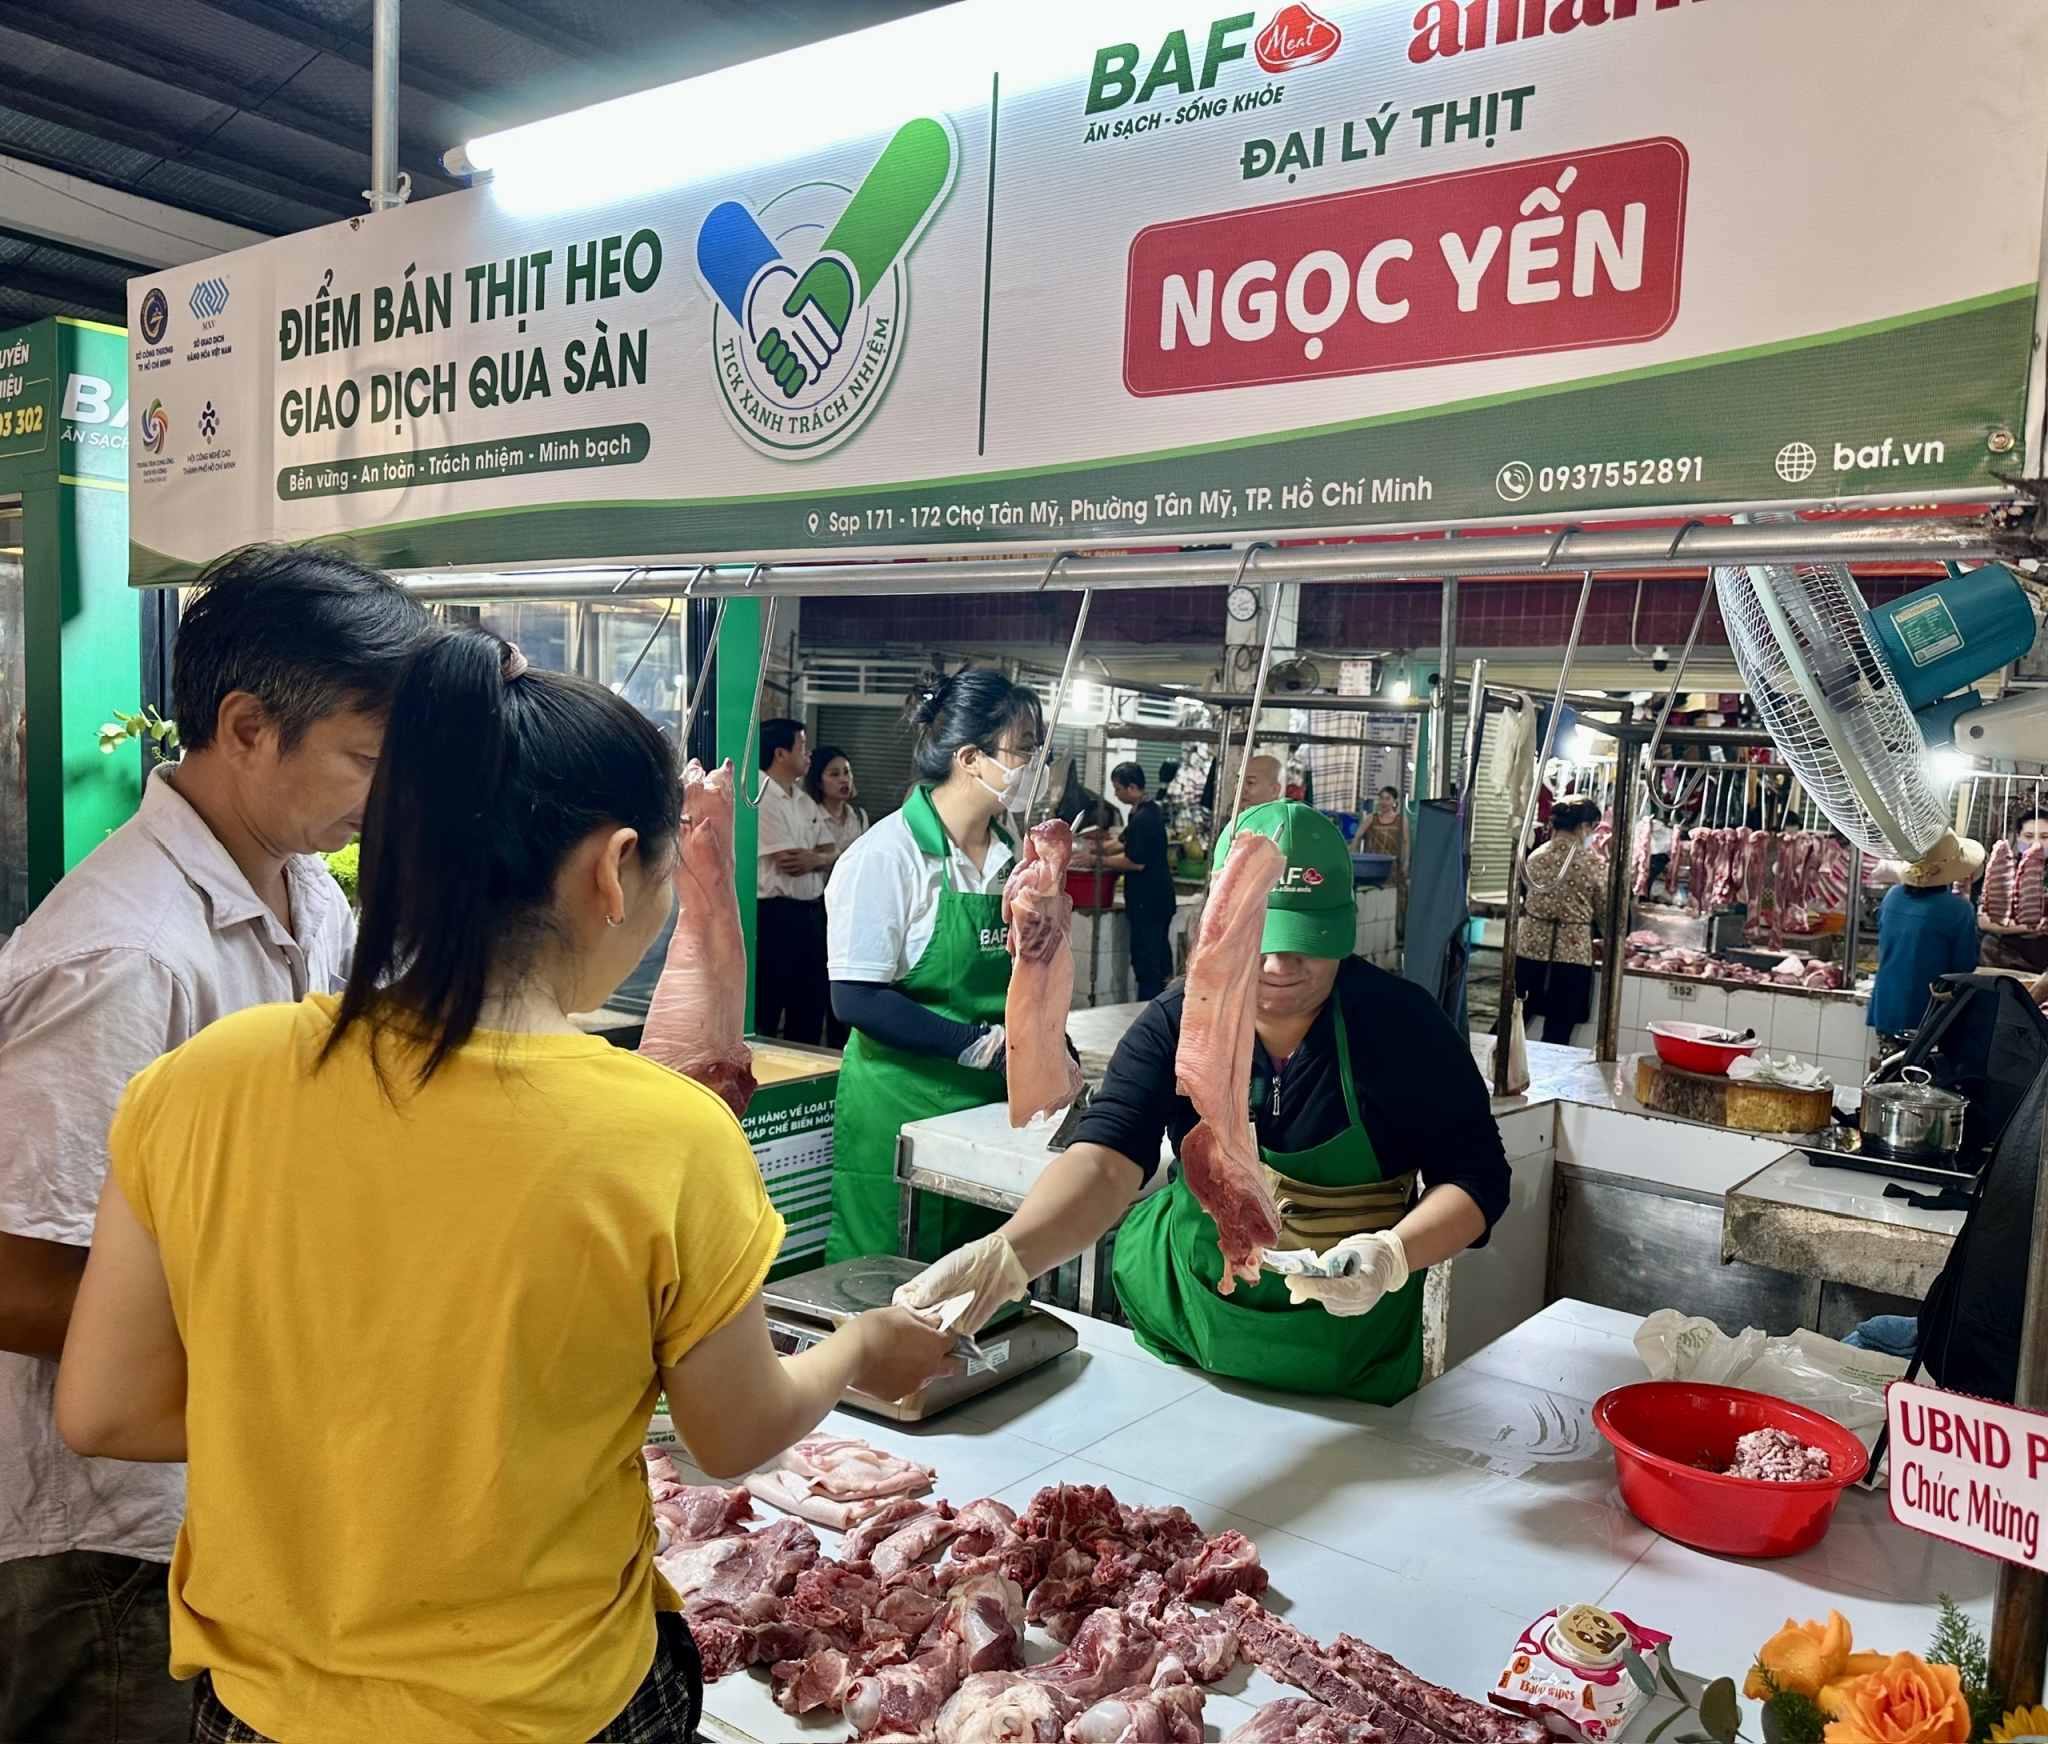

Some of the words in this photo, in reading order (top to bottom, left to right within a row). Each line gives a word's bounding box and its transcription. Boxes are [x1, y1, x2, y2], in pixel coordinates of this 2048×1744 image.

[1085, 12, 1256, 115] BAF
[1264, 24, 1318, 58] Meat
[1083, 122, 1109, 143] ĂN
[1112, 112, 1162, 140] SẠCH
[1175, 96, 1227, 125] SỐNG
[1232, 83, 1285, 113] KHỎE
[1239, 126, 1325, 184] ĐẠI
[1340, 101, 1401, 163] LÝ
[1412, 85, 1536, 149] THỊT
[1159, 237, 1414, 361] NGỌC
[1438, 165, 1647, 313] YẾN
[279, 268, 361, 361] ĐIỂM
[373, 261, 452, 343] BÁN
[465, 248, 553, 333] THỊT
[566, 228, 663, 305] HEO
[202, 320, 216, 331] MXV
[280, 379, 360, 437] GIAO
[371, 362, 456, 434] DỊCH
[468, 353, 551, 409] QUA
[563, 320, 648, 395] SÀN
[721, 338, 744, 393] TICK
[739, 388, 784, 434] XANH
[788, 394, 849, 434] TRÁCH
[848, 317, 890, 399] NHIỆM
[15, 405, 43, 435] 302
[61, 425, 86, 443] ĂN
[289, 471, 313, 492] Bền
[316, 469, 349, 491] vững
[360, 467, 379, 484] An
[383, 461, 415, 481] toàn
[429, 452, 470, 475] Trách
[475, 446, 524, 473] nhiệm
[539, 440, 579, 463] Minh
[585, 434, 631, 462] bạch
[1538, 456, 1704, 493] 0937552891
[1833, 437, 1944, 471] baf.vn
[829, 511, 860, 537] Sạp
[866, 509, 893, 530] 171
[911, 506, 940, 527] 172
[946, 504, 984, 531] Chợ
[990, 501, 1023, 524] Tân
[1030, 500, 1063, 526] Mỹ,
[1071, 495, 1148, 525] Phường
[1155, 492, 1192, 517] Tân
[1200, 489, 1237, 518] Mỹ,
[1246, 488, 1273, 512] TP.
[1282, 477, 1313, 509] Hồ
[1321, 477, 1366, 507] Chí
[1372, 476, 1432, 503] Minh
[980, 927, 1008, 945] BAF
[1673, 986, 1692, 996] 152
[758, 1110, 787, 1125] HÀNG
[804, 1101, 826, 1114] LOẠI
[768, 1119, 789, 1135] CHẾ
[791, 1115, 813, 1130] BIẾN
[1900, 1400, 2011, 1469] UBND
[1902, 1461, 1959, 1522] Chúc
[1967, 1479, 2039, 1560] Mừng
[1519, 1679, 1546, 1697] Baby
[1548, 1687, 1575, 1700] wipes
